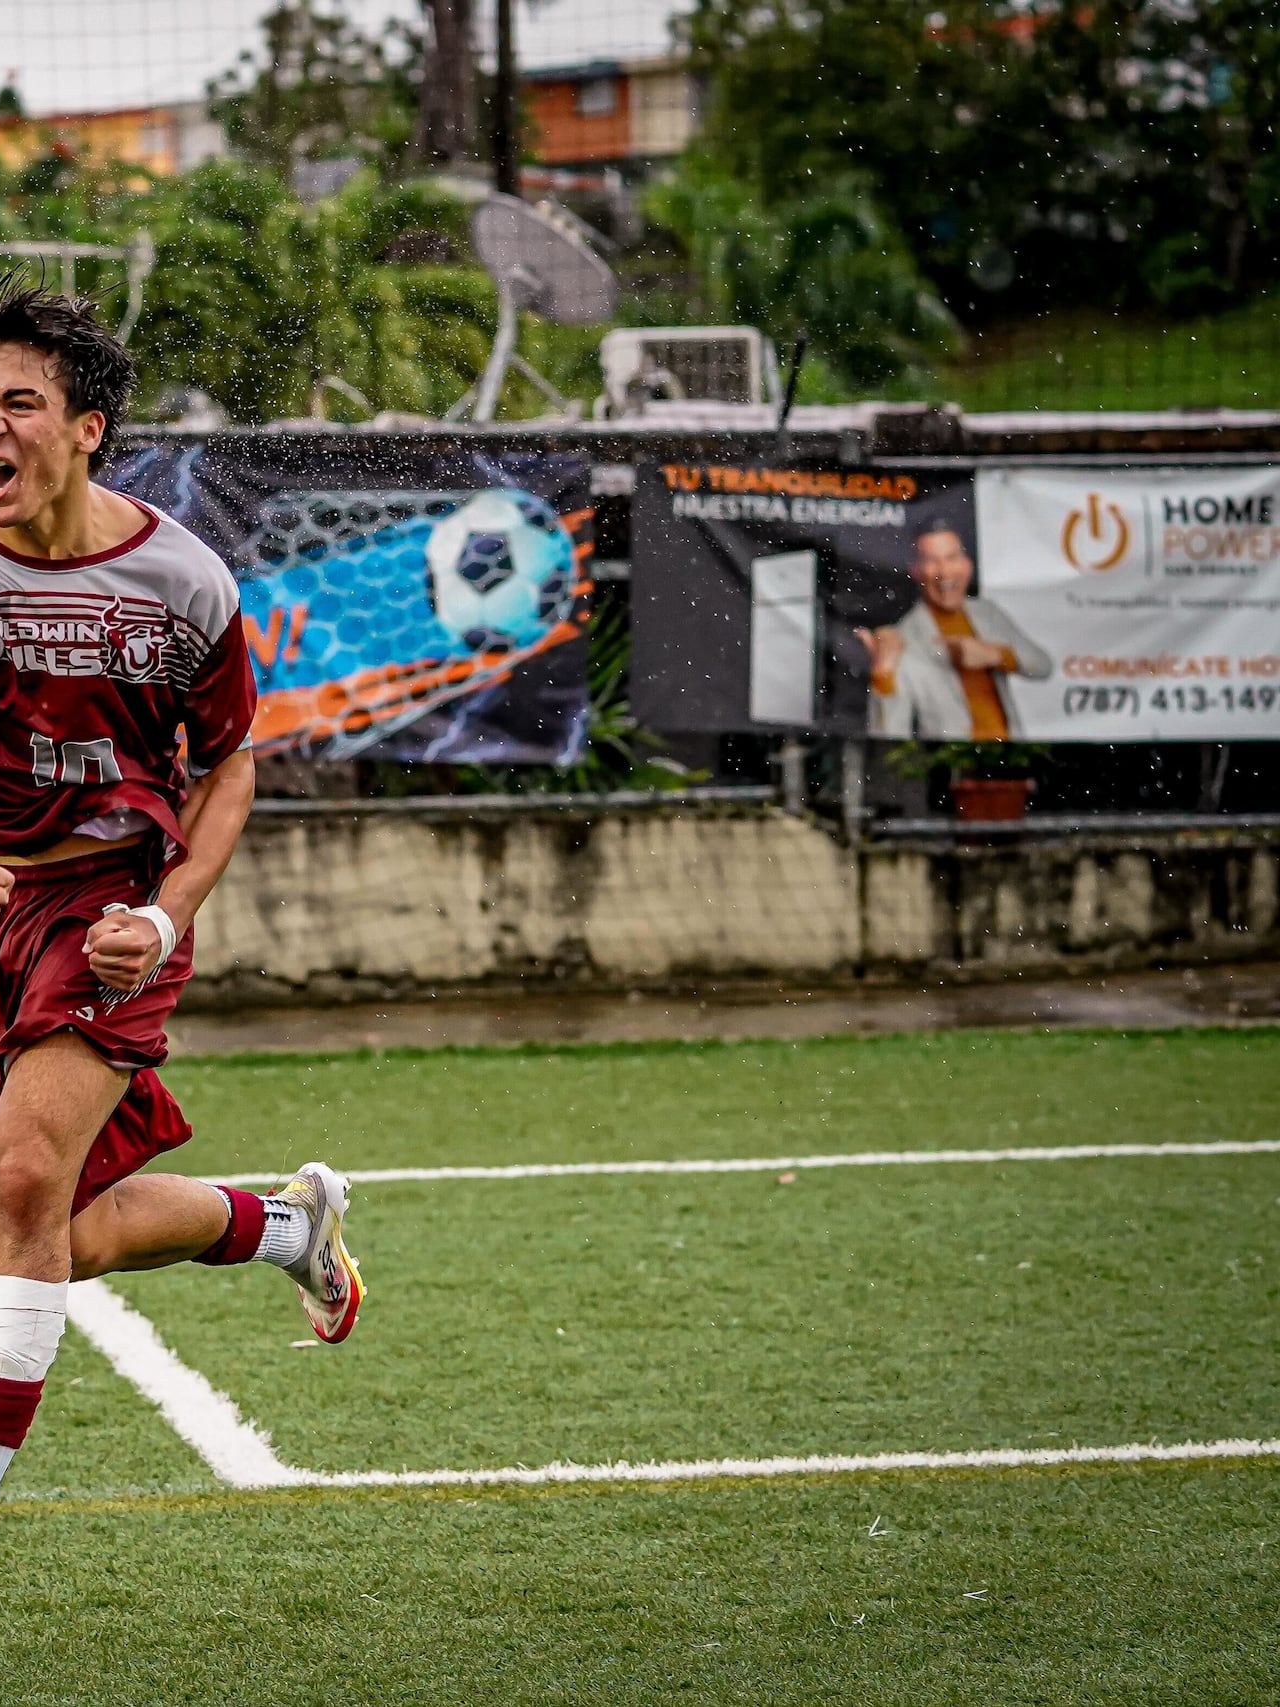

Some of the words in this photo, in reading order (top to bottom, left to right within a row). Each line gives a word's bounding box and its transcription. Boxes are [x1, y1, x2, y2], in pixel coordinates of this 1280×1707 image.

[663, 465, 701, 491] TU
[707, 466, 916, 499] TRANQUILIDAD
[672, 495, 789, 521] NUESTRA
[1163, 496, 1273, 524] HOME
[1063, 686, 1141, 717] (787)
[1149, 686, 1280, 713] 413-149
